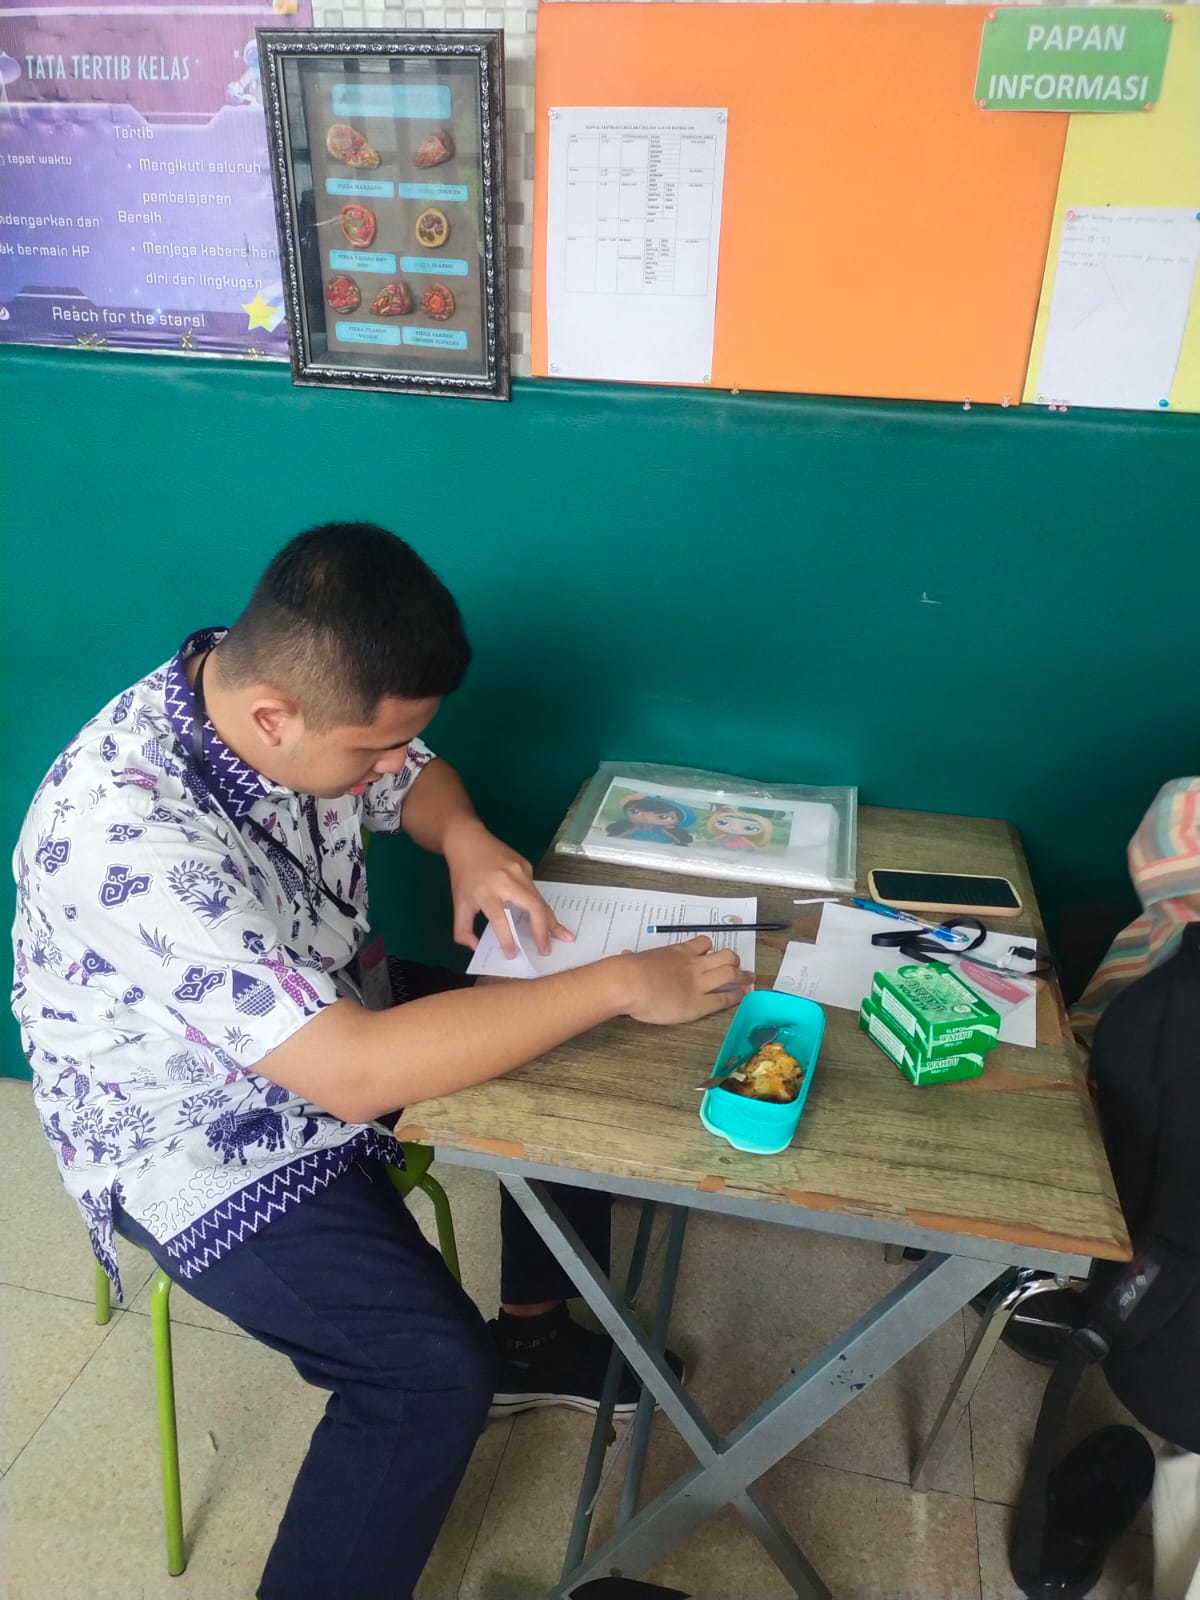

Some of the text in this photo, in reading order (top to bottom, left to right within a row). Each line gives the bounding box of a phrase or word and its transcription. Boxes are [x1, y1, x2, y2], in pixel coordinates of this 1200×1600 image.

[1027, 24, 1126, 52] PAPAN
[25, 55, 190, 82] TATA TERTIB KELAS
[988, 74, 1149, 101] INFORMASI
[113, 125, 154, 140] Tertib
[7, 153, 36, 167] tepat
[39, 153, 72, 166] waktu
[139, 158, 261, 175] Mengikuti seluruh
[143, 191, 232, 207] pembelajaran
[77, 215, 100, 228] dan
[118, 210, 162, 224] Bersih
[17, 243, 68, 257] bermain
[72, 244, 90, 257] HP
[143, 241, 276, 259] Menjaga kebersihan
[146, 271, 167, 285] diri
[172, 273, 195, 286] dan
[52, 306, 206, 329] Reach for the stars!
